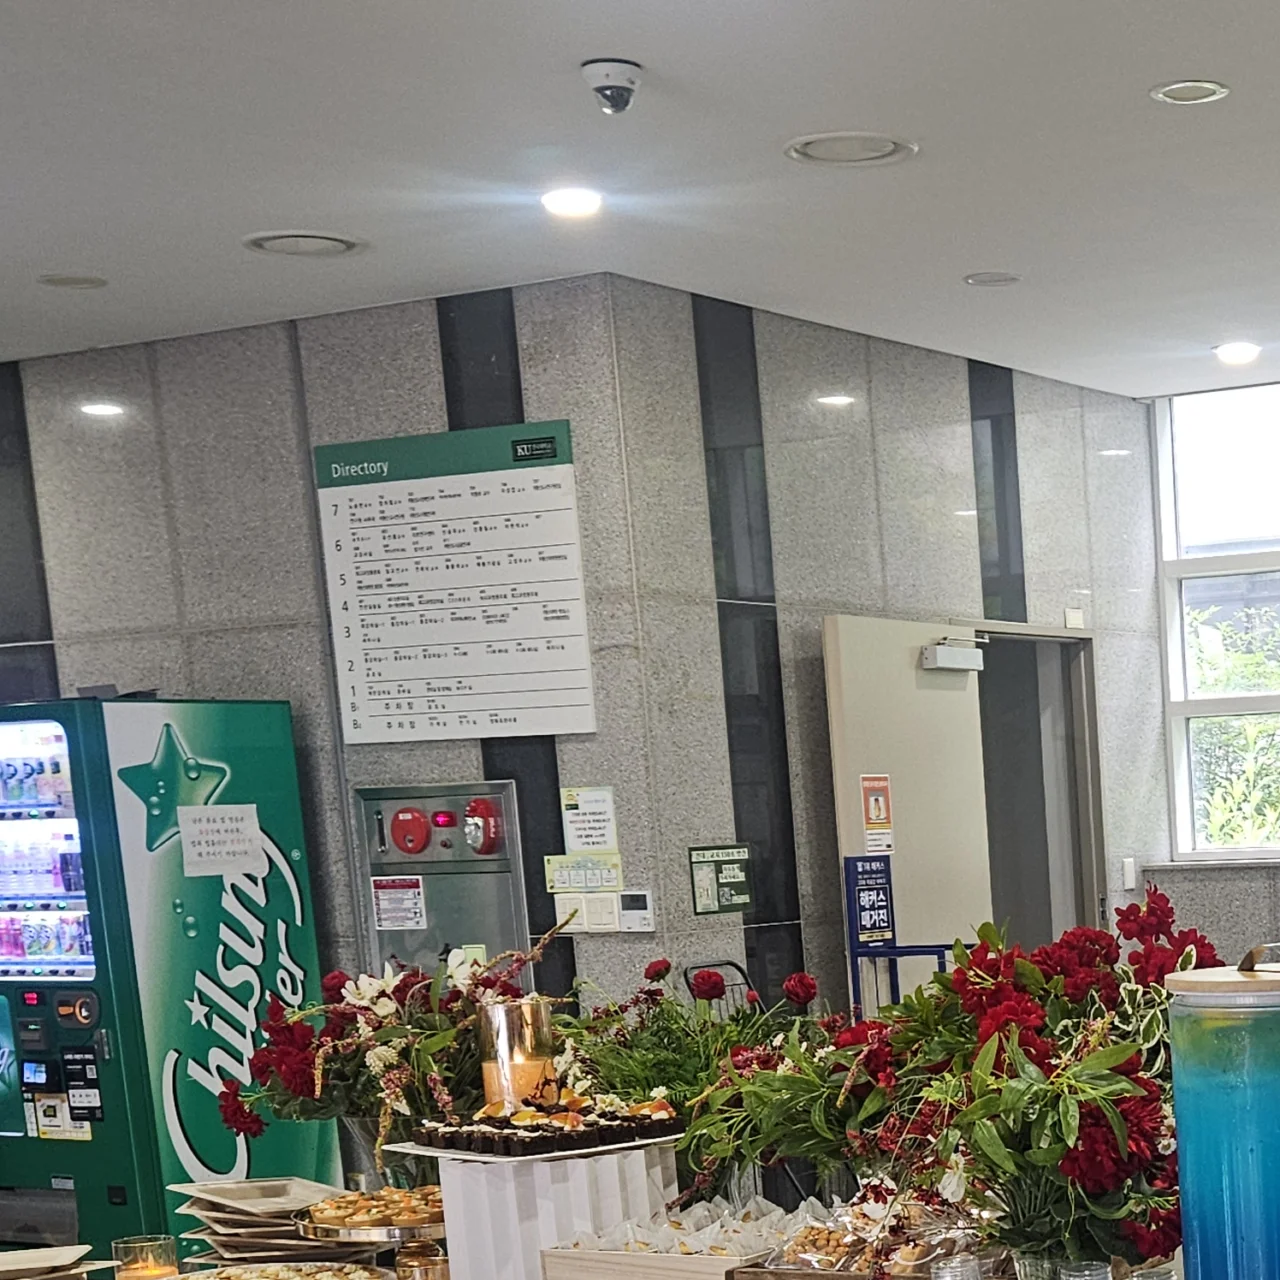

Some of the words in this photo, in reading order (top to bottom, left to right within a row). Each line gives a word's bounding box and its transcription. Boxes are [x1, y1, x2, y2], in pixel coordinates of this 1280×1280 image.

[331, 460, 389, 479] Directory
[331, 504, 339, 516] 7
[335, 540, 342, 551] 6
[339, 574, 347, 586] 5
[341, 601, 349, 612] 4
[344, 627, 351, 638] 3
[347, 661, 355, 672] 2
[351, 685, 356, 696] 1
